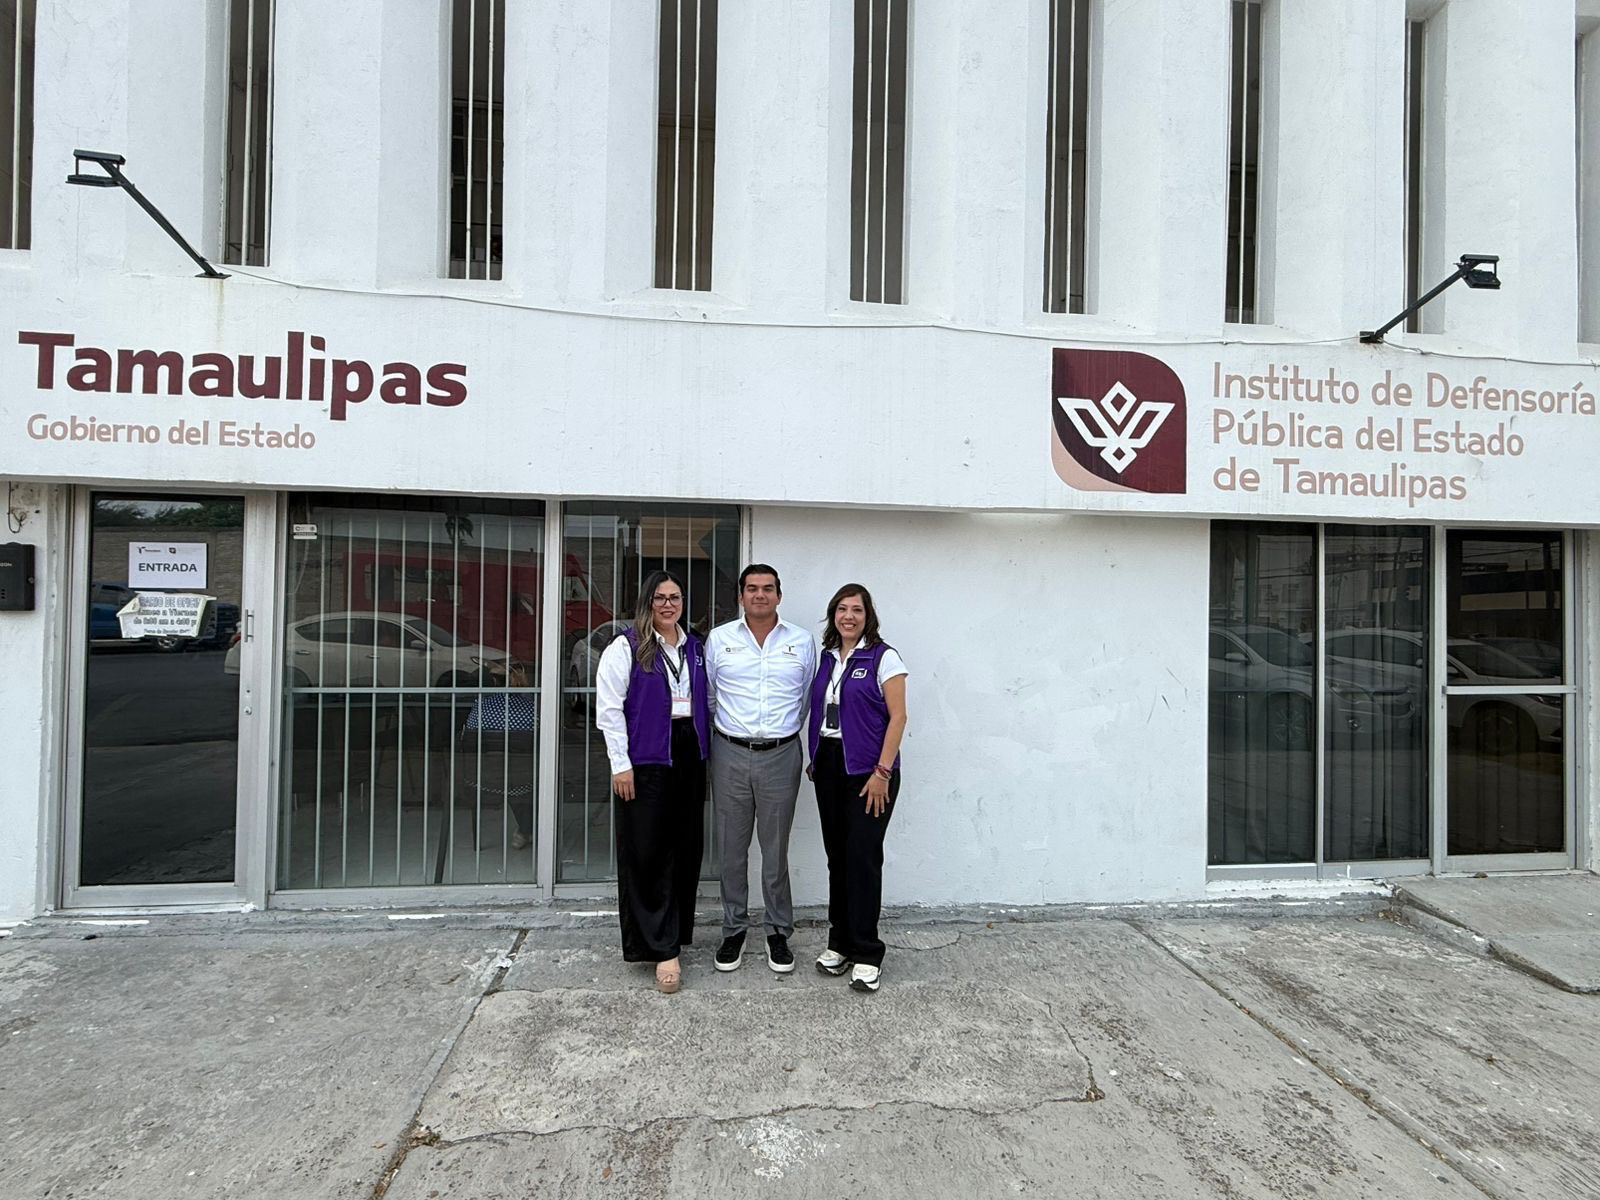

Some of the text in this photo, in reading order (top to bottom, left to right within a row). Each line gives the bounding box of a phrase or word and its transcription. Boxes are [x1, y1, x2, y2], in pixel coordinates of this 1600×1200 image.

[19, 330, 468, 422] Tamaulipas
[1213, 361, 1597, 416] Instituto de Defensoría
[26, 413, 317, 450] Gobierno del Estado
[1213, 408, 1524, 457] Pública del Estado
[1213, 456, 1468, 508] de Tamaulipas
[139, 563, 197, 572] ENTRADA
